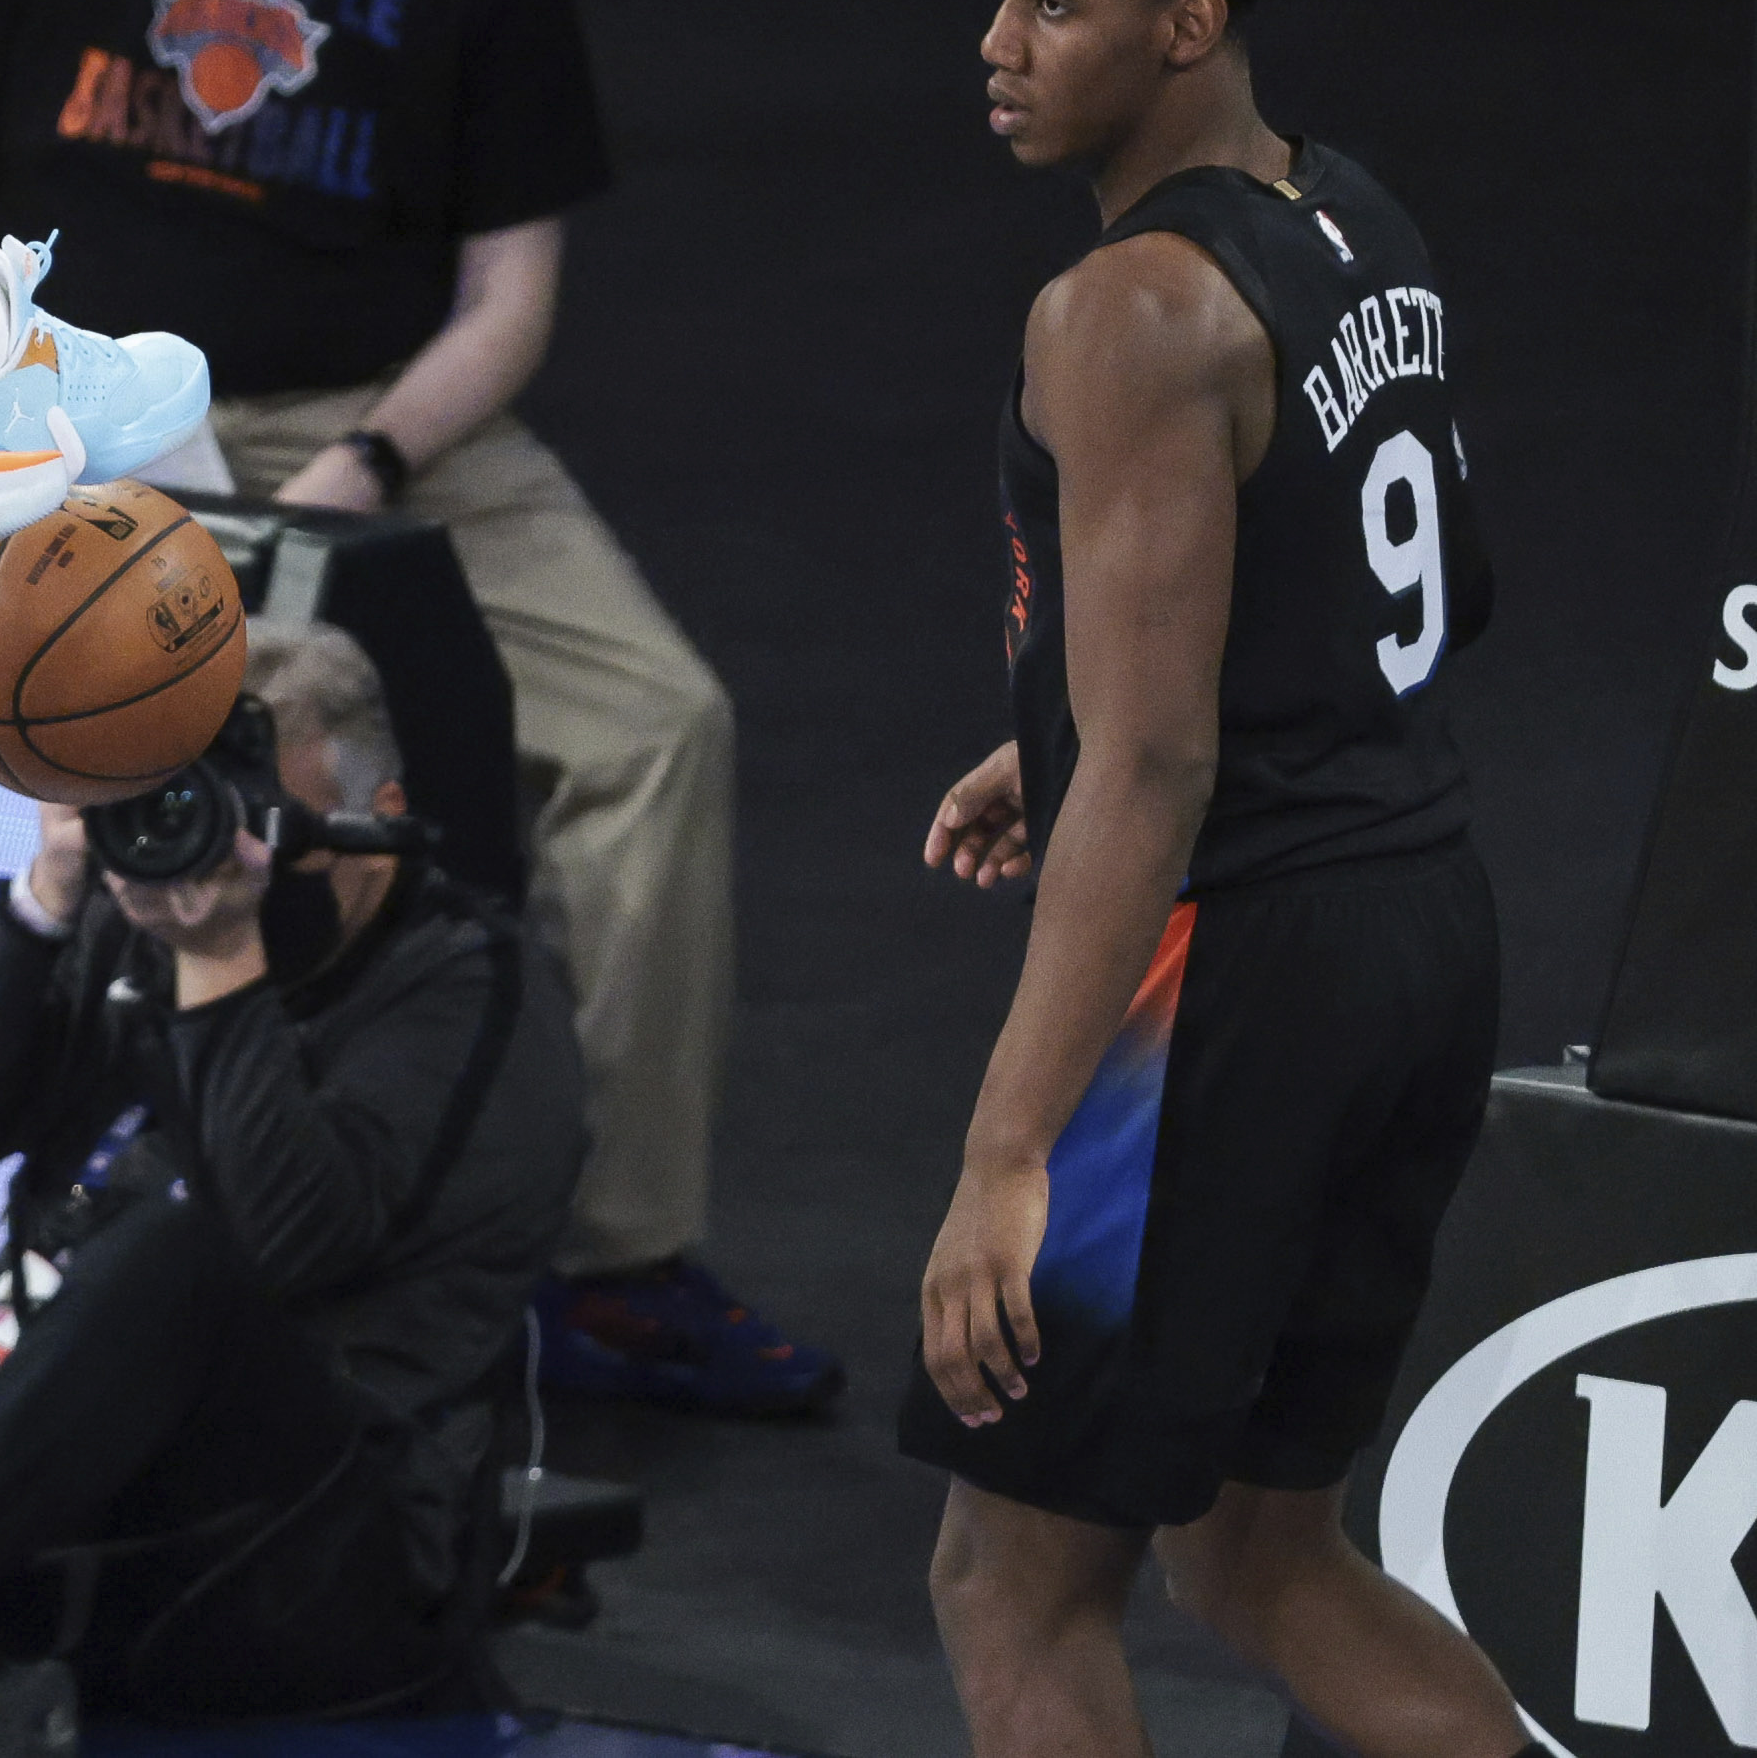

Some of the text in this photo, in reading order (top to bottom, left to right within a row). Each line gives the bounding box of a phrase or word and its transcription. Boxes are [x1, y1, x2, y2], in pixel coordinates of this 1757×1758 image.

[57, 49, 376, 200] BASKBALL
[1302, 287, 1444, 454] BARRETT
[1361, 429, 1448, 698] 9
[1574, 1373, 1757, 1750] K
